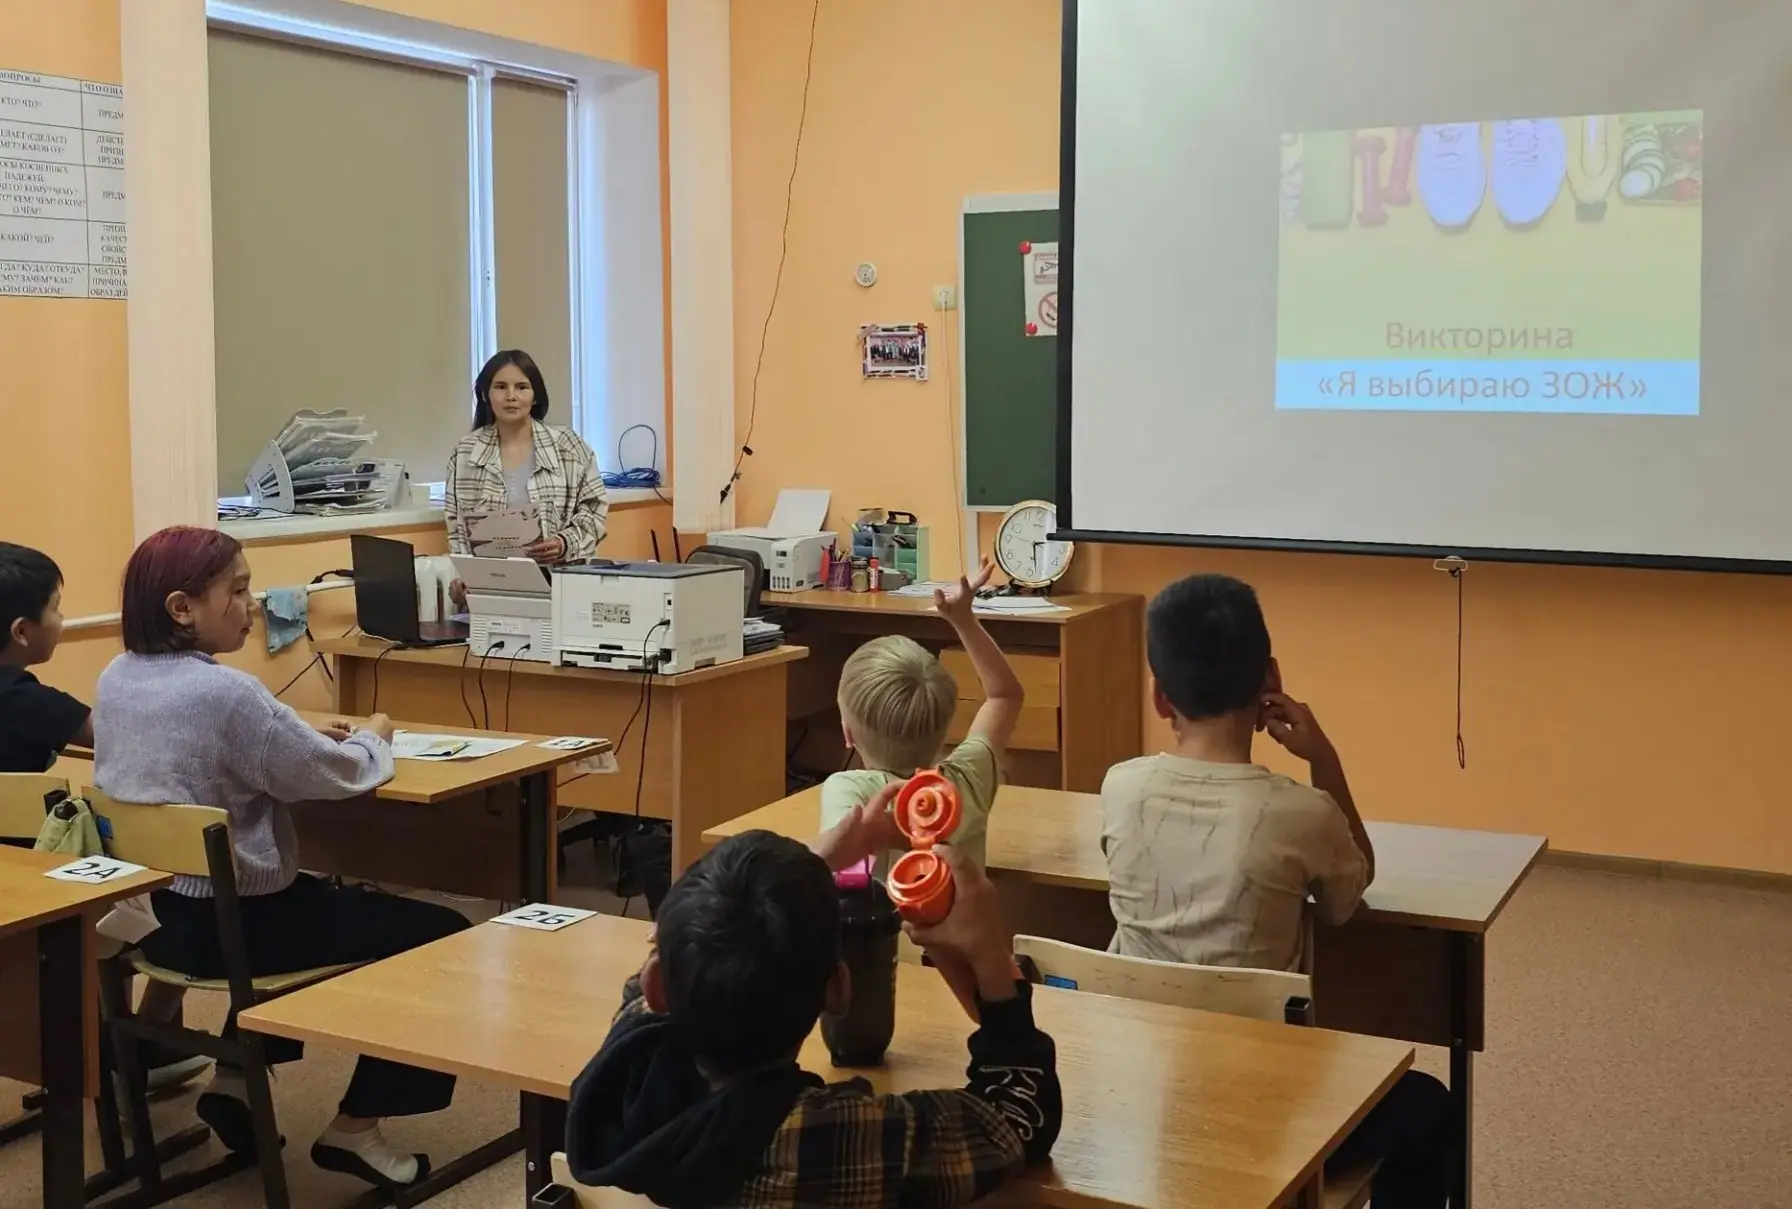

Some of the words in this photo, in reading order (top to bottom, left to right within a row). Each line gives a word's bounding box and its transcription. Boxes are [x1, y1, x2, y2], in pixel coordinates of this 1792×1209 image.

[1385, 321, 1574, 355] Викторина
[1318, 371, 1357, 398] «Я
[1369, 370, 1530, 404] выбираю
[1542, 372, 1648, 401] ЗОЖ»
[62, 862, 121, 879] 2А
